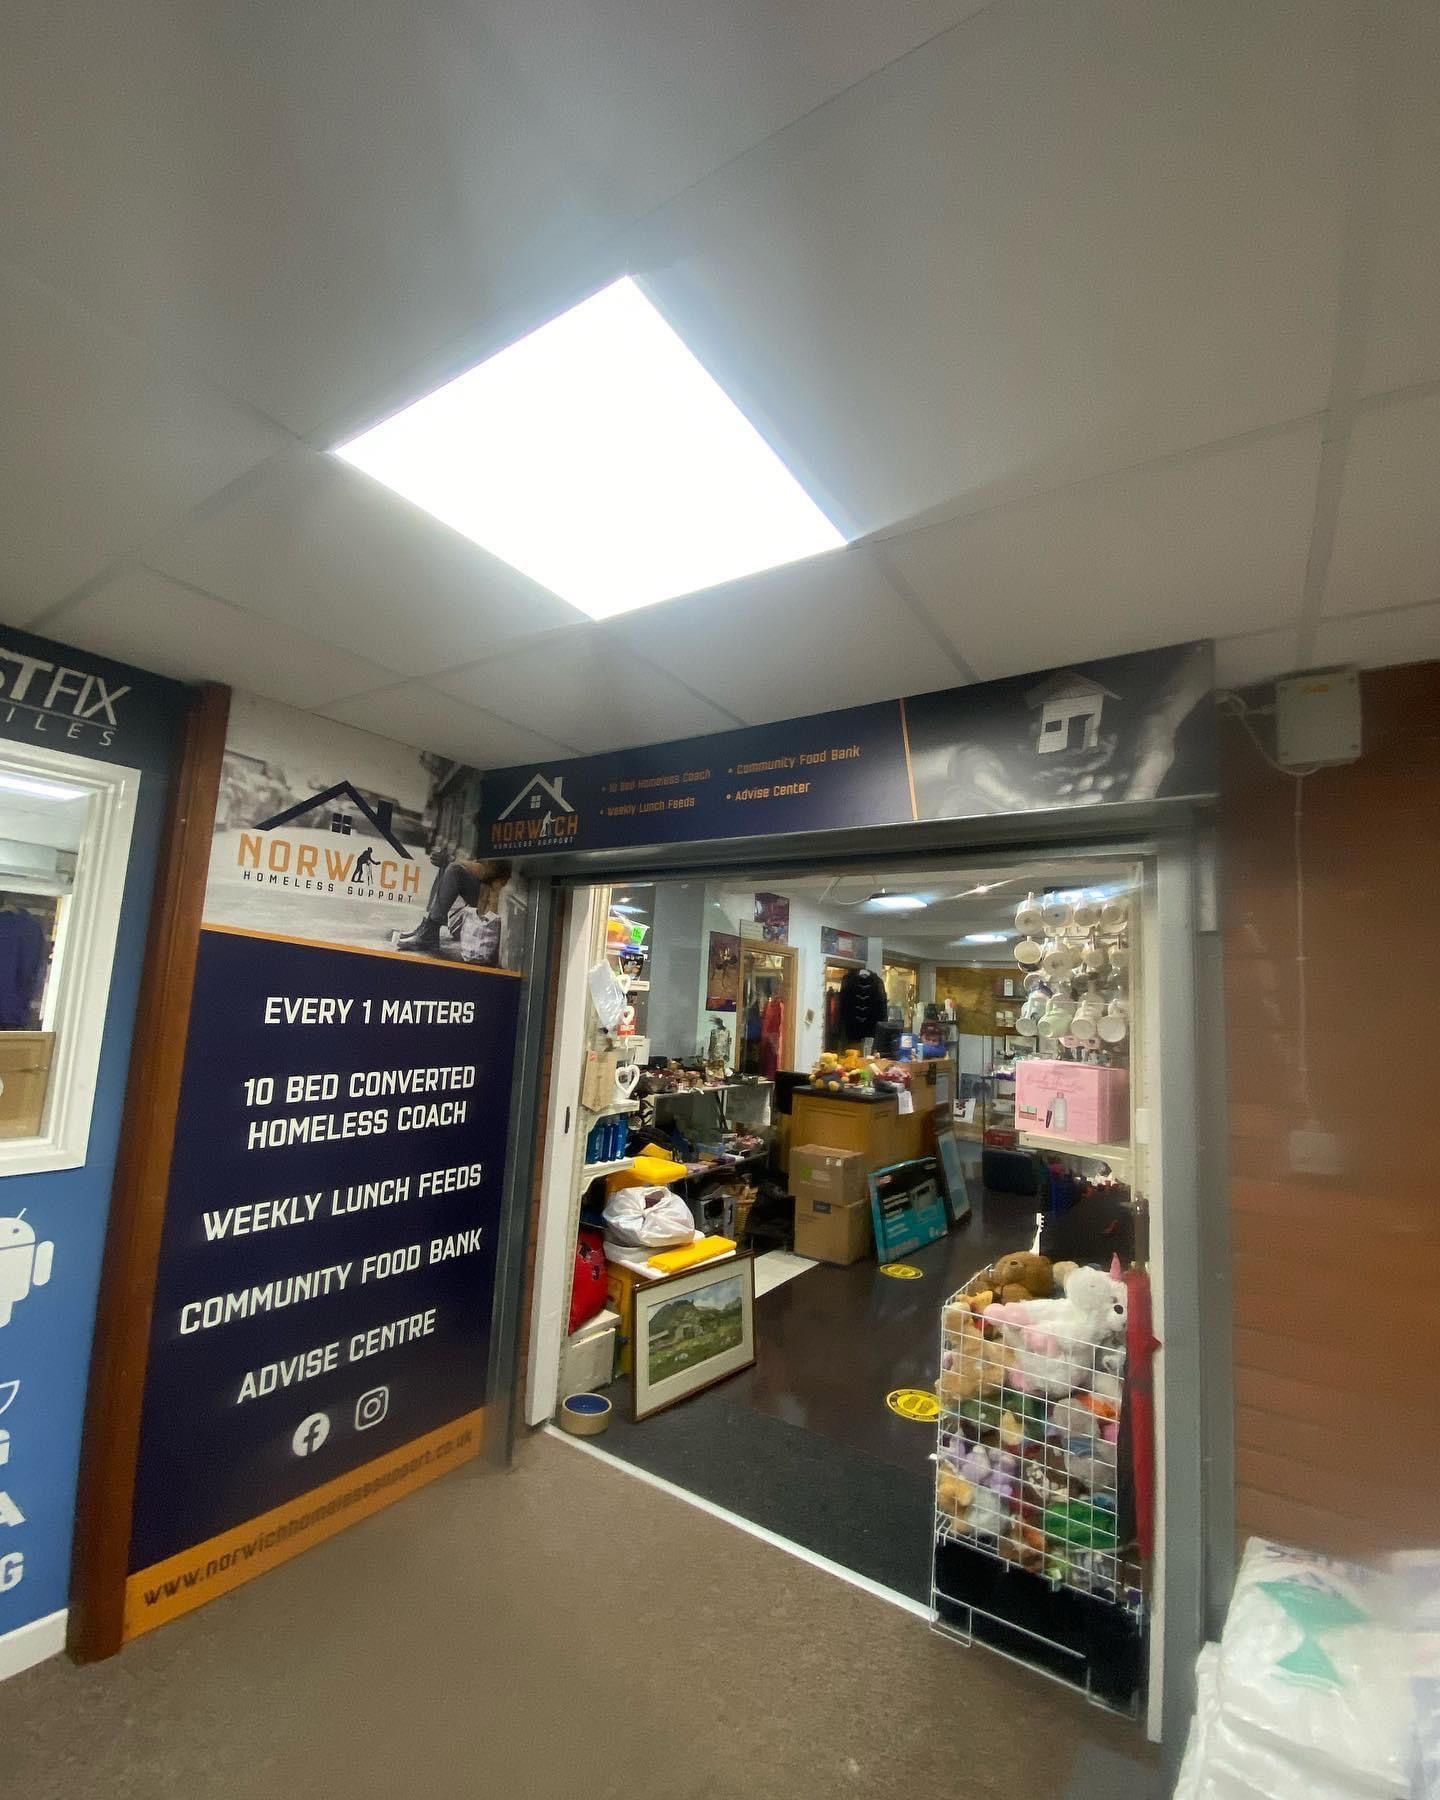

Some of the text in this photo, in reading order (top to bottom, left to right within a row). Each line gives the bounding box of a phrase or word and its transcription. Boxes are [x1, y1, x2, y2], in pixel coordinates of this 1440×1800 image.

[683, 769, 711, 783] Coach
[737, 745, 860, 775] Community Food Bank
[640, 801, 665, 813] Lunch
[668, 796, 695, 809] Feeds
[735, 782, 811, 801] Advise Center
[243, 870, 413, 904] HOMELESS SUPPORT
[264, 996, 475, 1025] EVERY 1 MATTERS
[244, 1065, 476, 1107] 10 BED CONVERTED
[247, 1101, 467, 1150] HOMELESS COACH
[203, 1163, 483, 1242] WEEKLY LUNCH FEEDS
[180, 1228, 483, 1335] COMMUNITY FOOD BANK
[237, 1308, 437, 1405] ADVISE CENTRE
